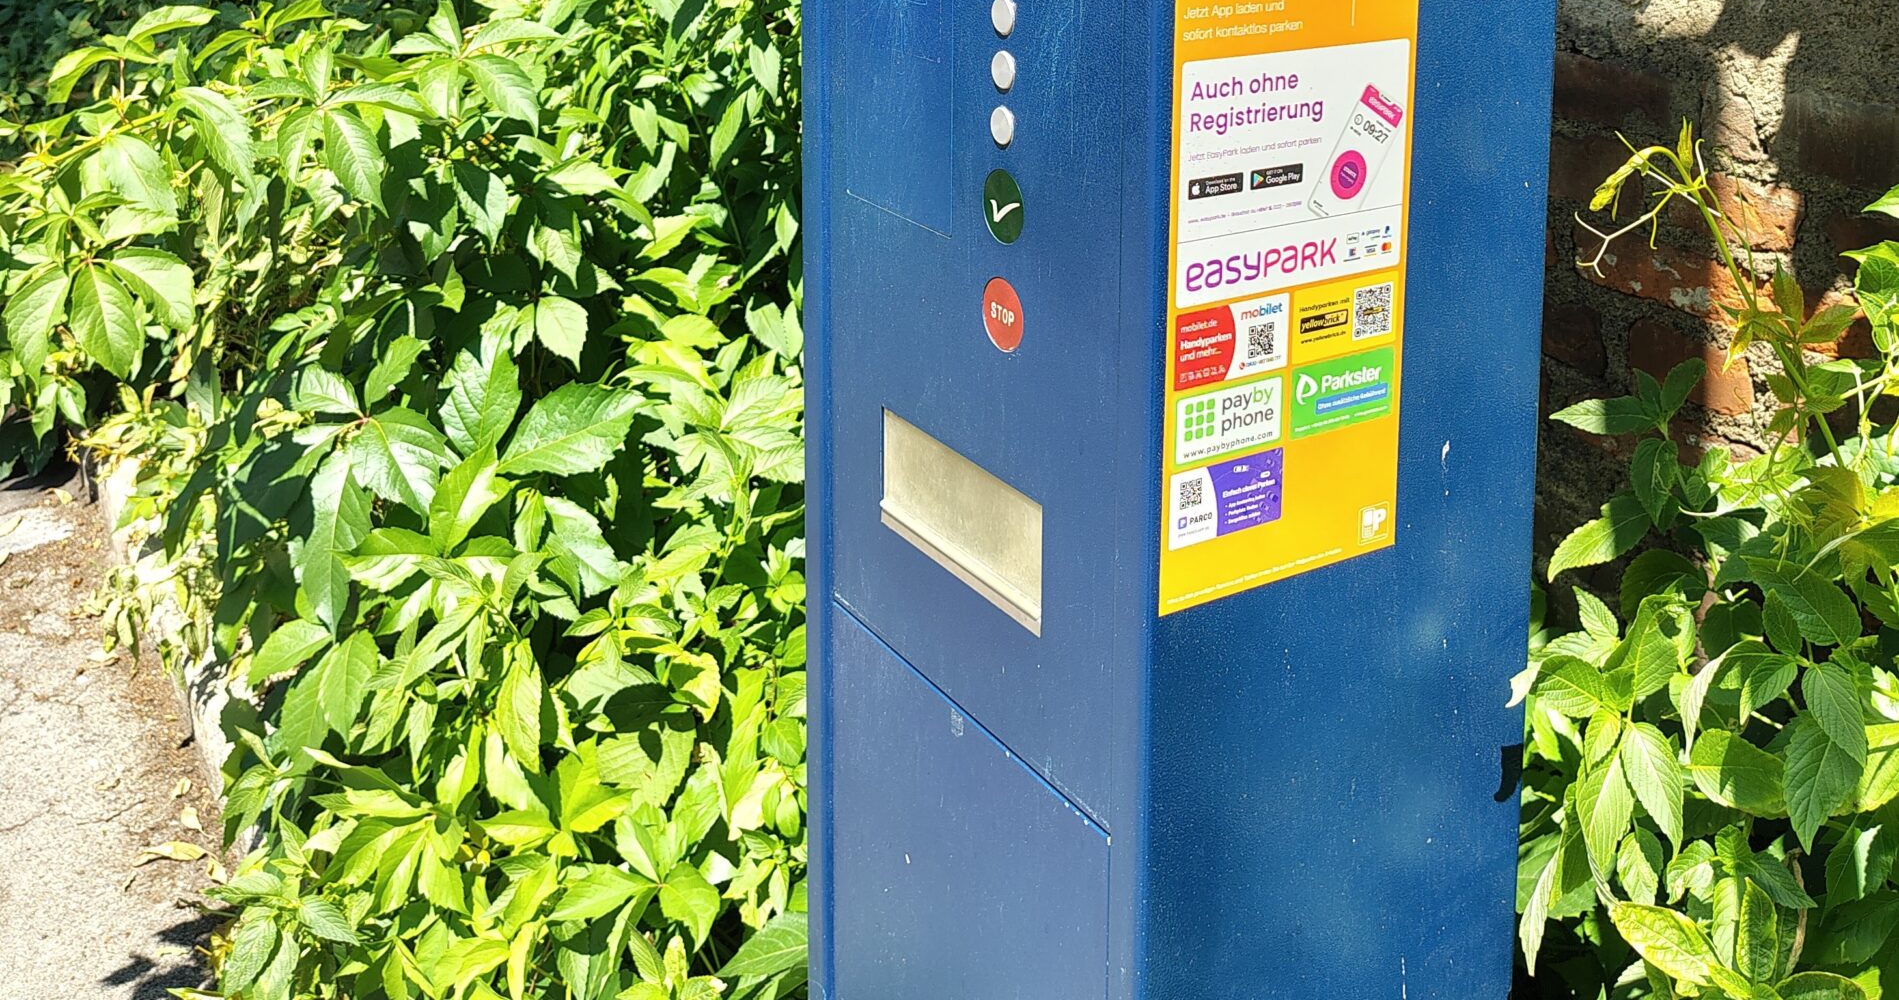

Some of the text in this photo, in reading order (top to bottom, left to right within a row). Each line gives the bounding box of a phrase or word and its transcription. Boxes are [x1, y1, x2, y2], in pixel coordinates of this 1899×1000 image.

[1184, 0, 1285, 20] Jetzt App laden und
[1182, 20, 1304, 42] sofort kontaktlos parken
[1190, 72, 1299, 102] Auch ohne
[1190, 100, 1324, 136] Registrierung
[1362, 120, 1389, 144] 09:27
[1188, 152, 1206, 162] Jetzt
[1240, 145, 1261, 155] laden
[1262, 142, 1276, 152] und
[1277, 140, 1298, 151] sofort
[1298, 136, 1323, 149] parken
[1204, 182, 1238, 195] App Store
[1266, 172, 1300, 185] Google Play
[990, 302, 1014, 327] STOP
[1240, 302, 1283, 321] mobilet
[1300, 300, 1339, 313] Handyparken
[1180, 318, 1218, 334] mobilet.de
[1180, 332, 1232, 351] Handyparken
[1180, 352, 1195, 363] und
[1221, 408, 1274, 437] phone
[1183, 430, 1274, 460] www.paybyphone.com
[1190, 512, 1213, 525] PARCO
